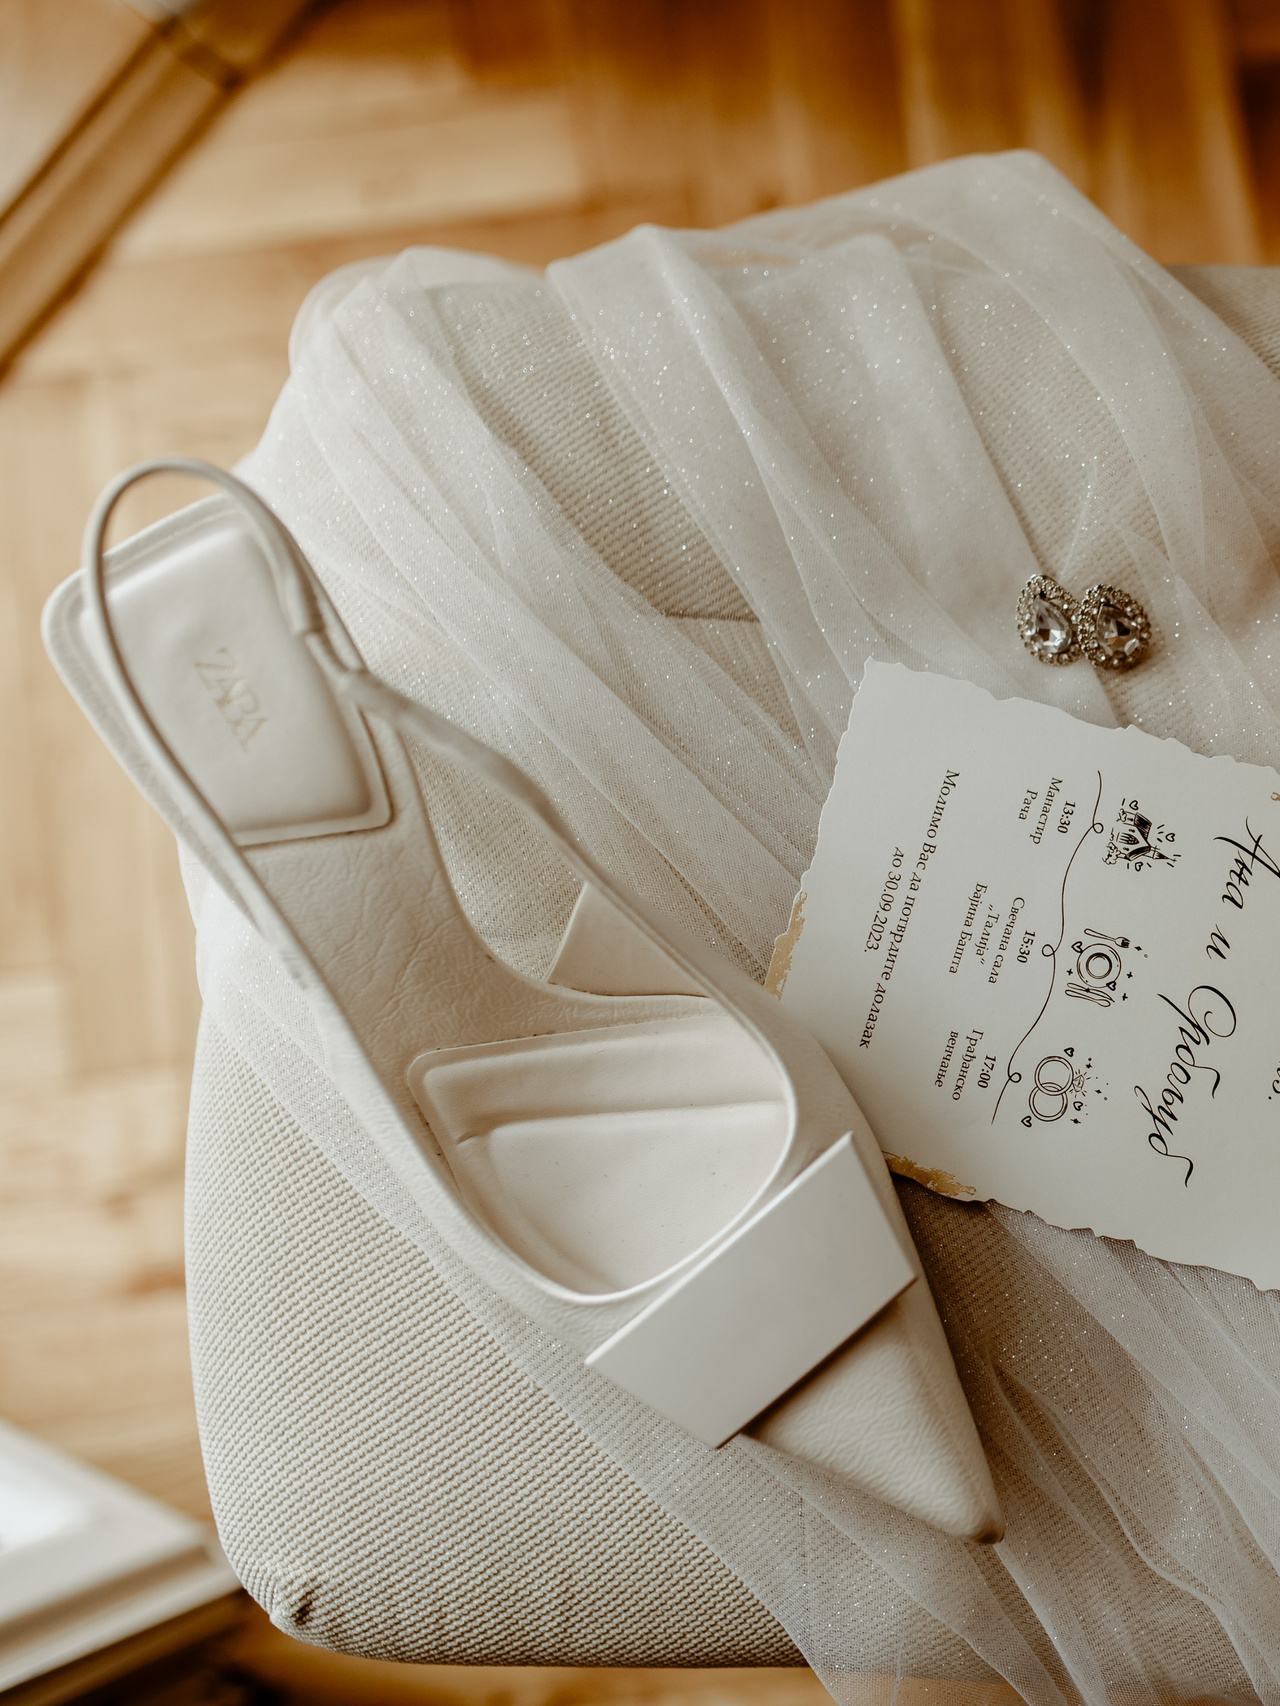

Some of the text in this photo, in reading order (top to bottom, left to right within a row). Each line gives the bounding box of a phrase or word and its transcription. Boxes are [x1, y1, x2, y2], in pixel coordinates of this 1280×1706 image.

[193, 647, 269, 754] ZARA
[1018, 789, 1039, 821] Рача
[1029, 777, 1064, 845] Манастир
[1056, 800, 1076, 834] 13:30
[858, 768, 961, 1049] Молимо Вас да потврдите долазак
[863, 846, 905, 953] до 30.09.2023.
[948, 882, 989, 974] Бајина Башта
[987, 896, 1026, 984] Свечана сала
[1016, 929, 1036, 964] 15:30
[1205, 923, 1231, 960] и
[934, 1030, 959, 1088] венчање
[951, 1028, 985, 1101] Грађанско
[977, 1054, 997, 1089] 17:00
[1133, 984, 1237, 1189] Србољуб
